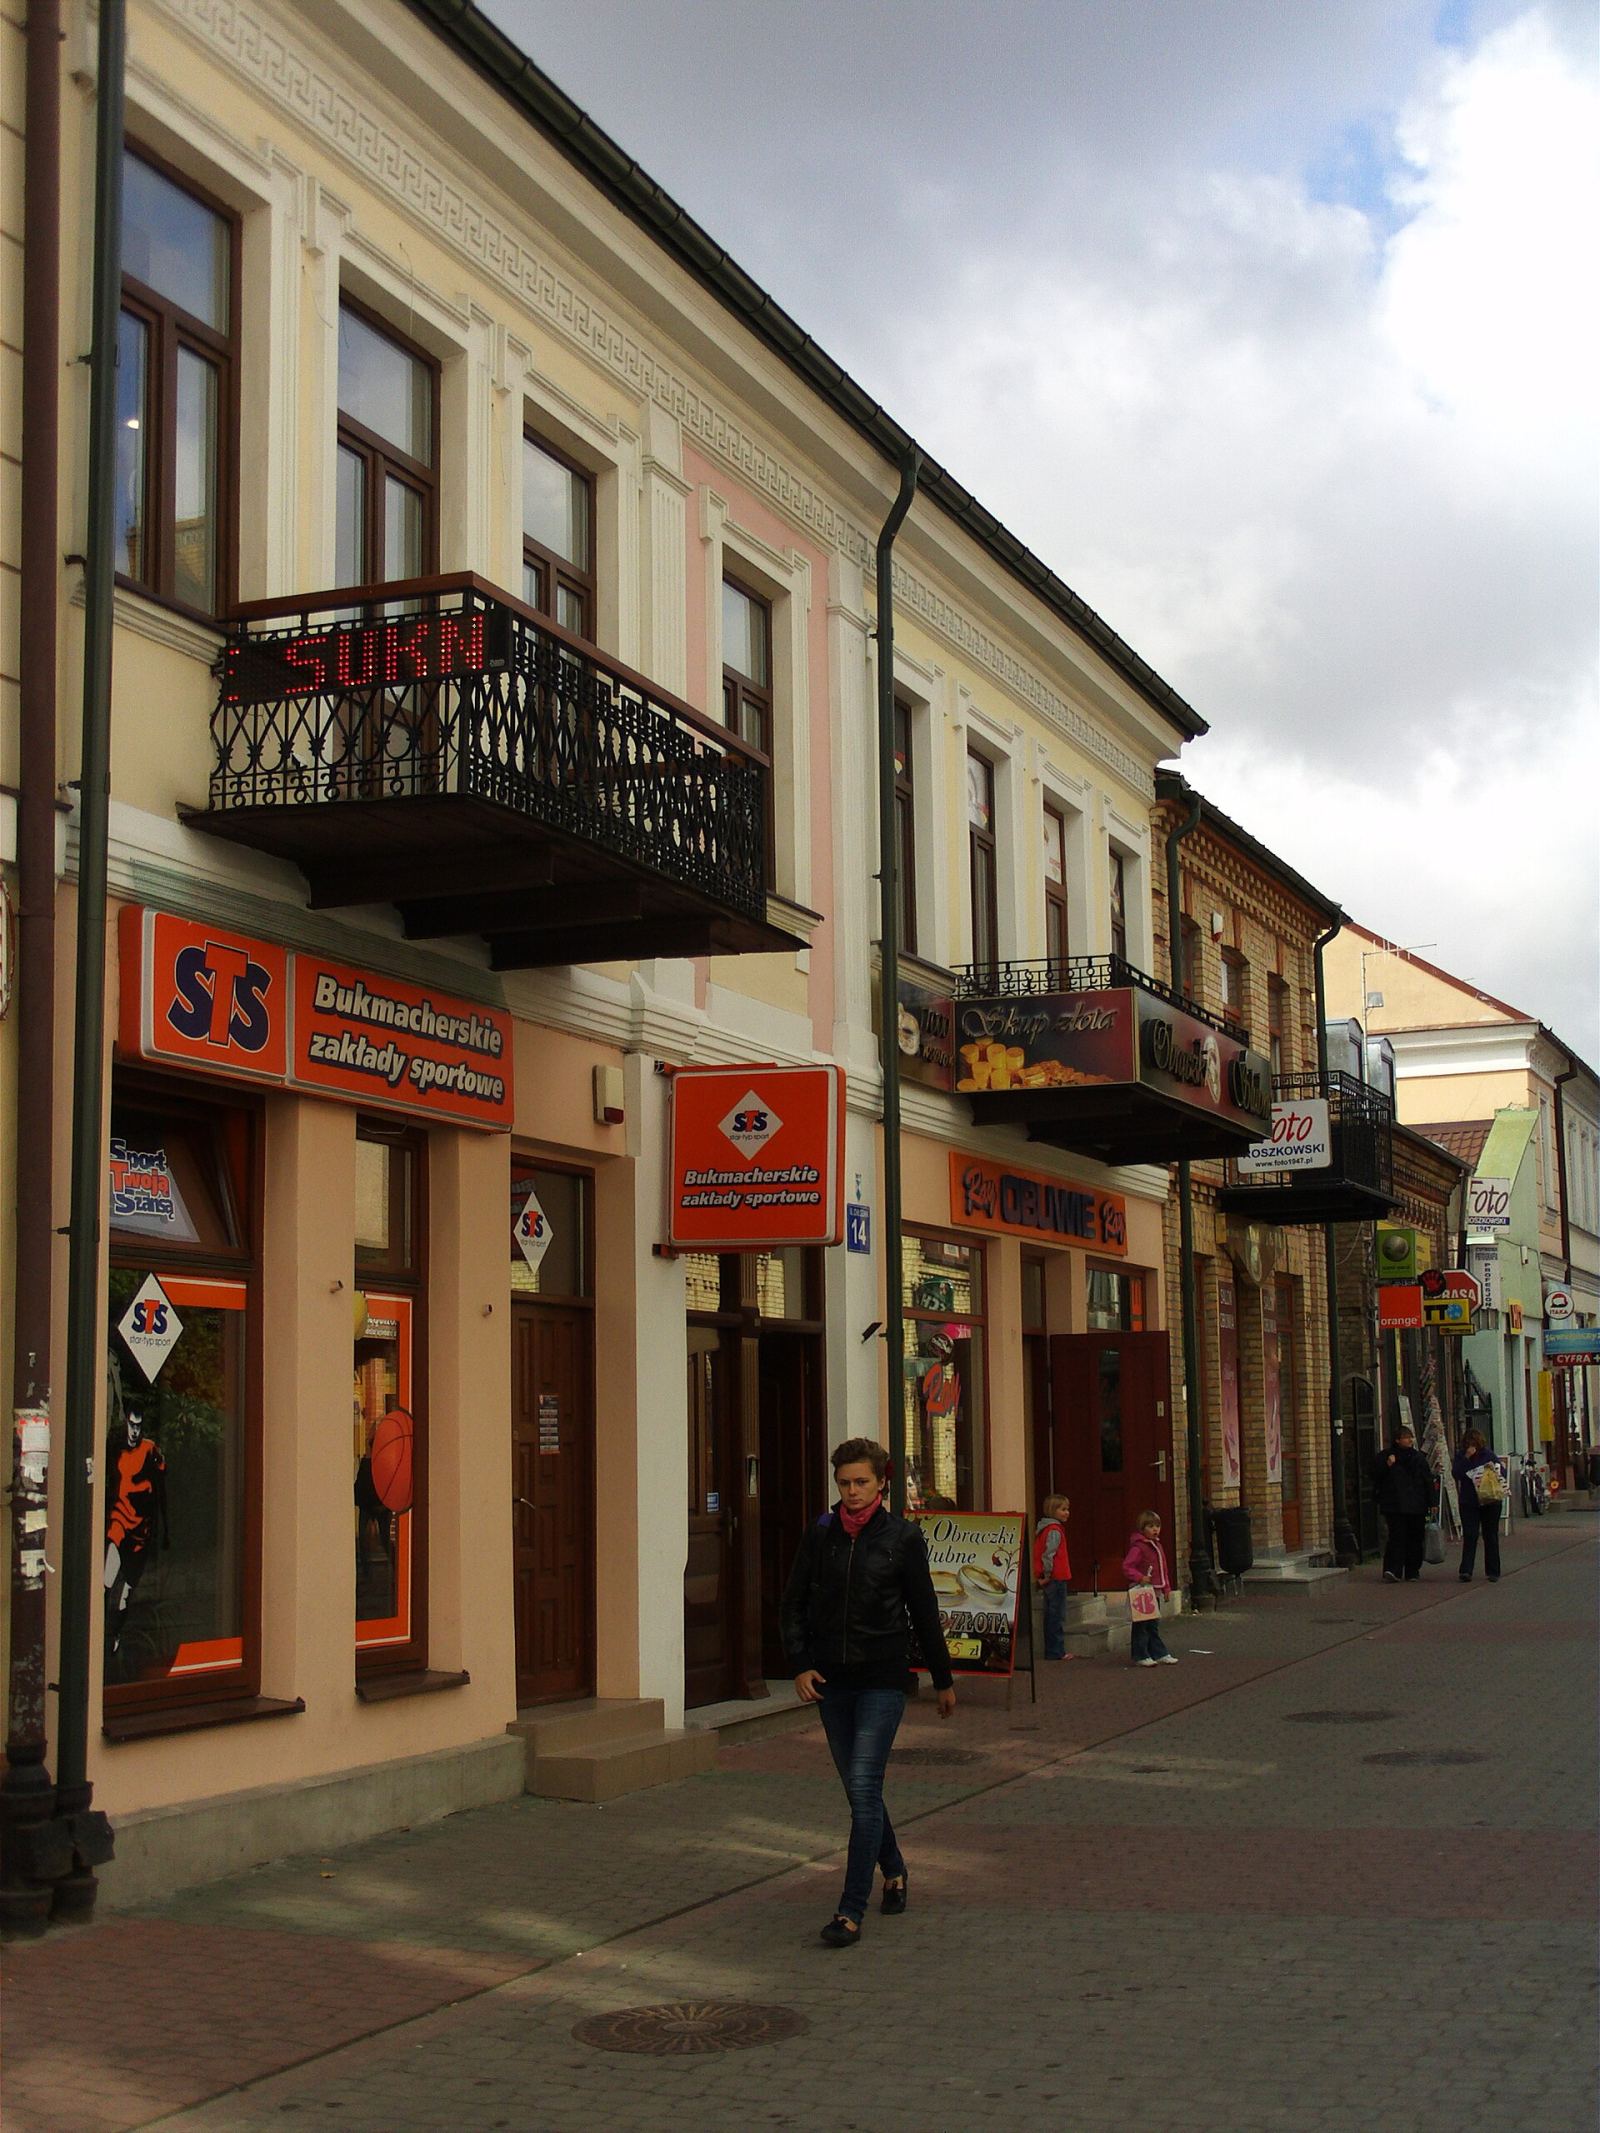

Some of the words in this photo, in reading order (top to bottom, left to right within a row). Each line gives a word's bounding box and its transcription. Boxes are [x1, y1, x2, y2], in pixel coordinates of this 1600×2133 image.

[167, 940, 273, 1053] STS
[314, 974, 502, 1054] Bukmacherskie
[961, 1007, 1049, 1045] Skup
[1055, 1000, 1118, 1034] złota
[310, 1033, 407, 1082] zakłady
[408, 1055, 505, 1100] sportowe
[732, 1110, 769, 1132] STS
[110, 1137, 167, 1174] Sport
[1255, 1157, 1313, 1168] www.foto1947.pl
[684, 1167, 819, 1186] Bukmacherskie
[682, 1192, 742, 1208] zakłady
[744, 1191, 820, 1205] sportowe
[1001, 1174, 1097, 1239] OBUWIE
[522, 1211, 543, 1238] STS
[851, 1218, 867, 1246] 14
[1441, 1288, 1477, 1303] RASA
[131, 1299, 169, 1335] STS
[1381, 1317, 1418, 1327] orange
[1556, 1353, 1591, 1363] CYFRA
[933, 1519, 1017, 1548] Obrączki
[926, 1544, 977, 1565] lubne
[949, 1611, 1011, 1635] ZŁOTA
[969, 1644, 979, 1657] zł
